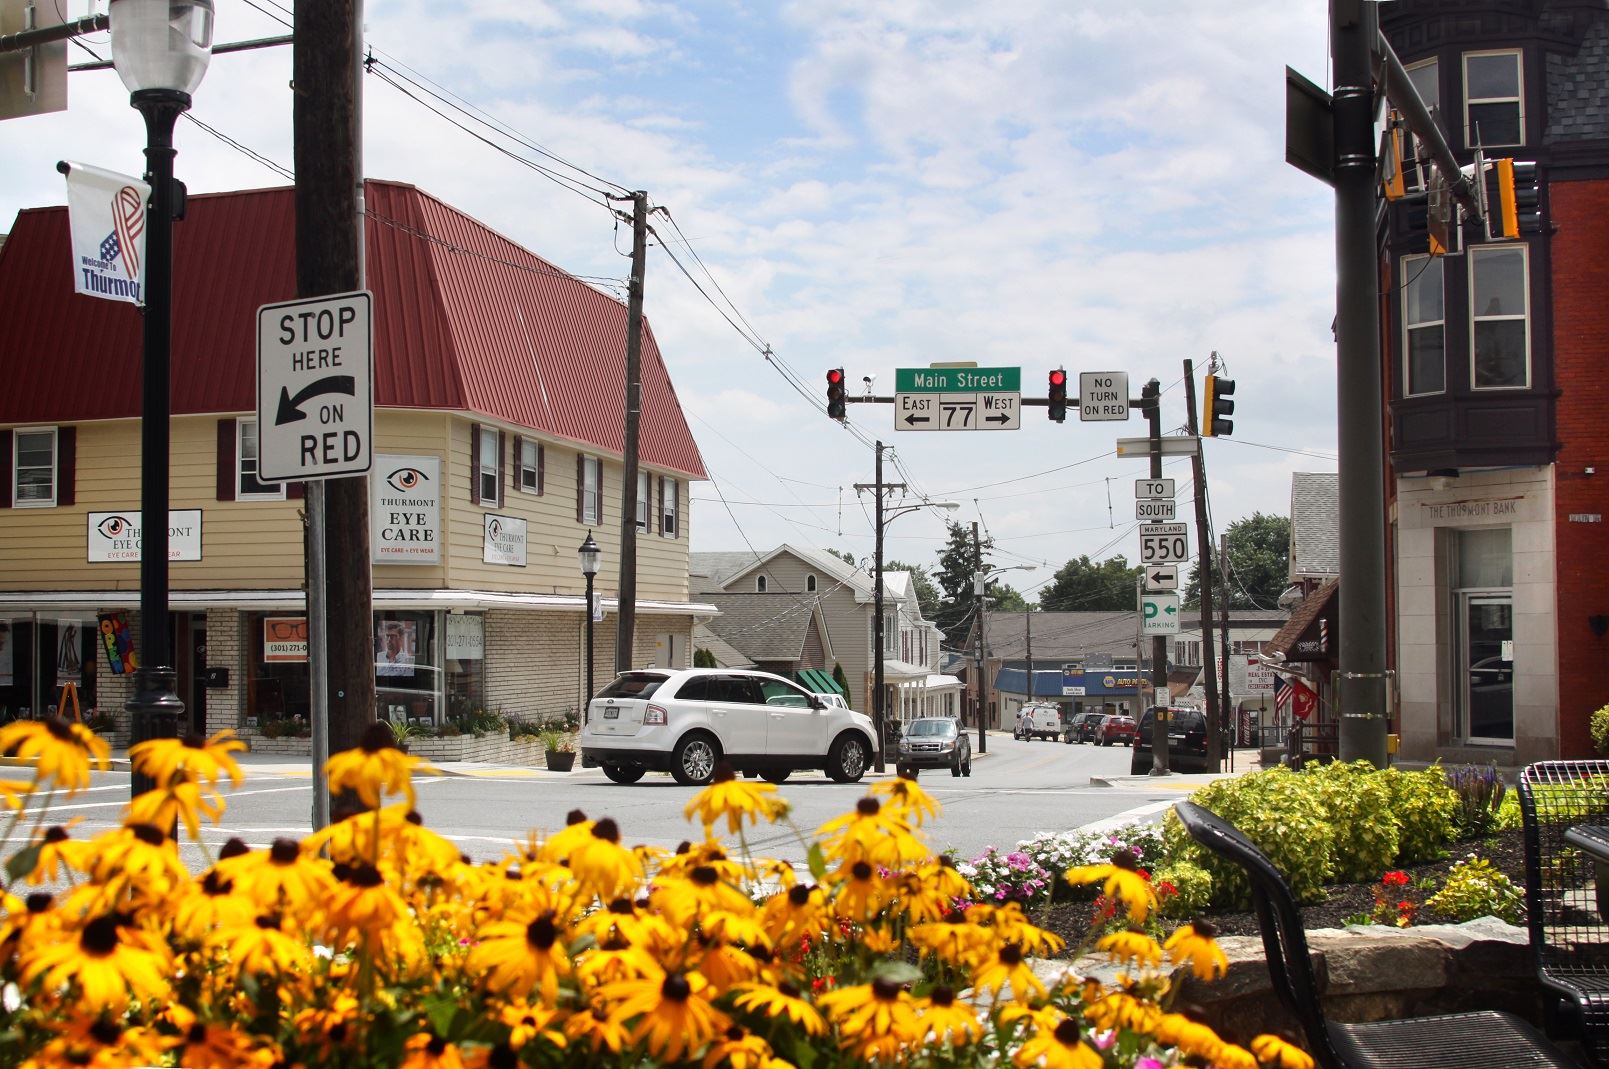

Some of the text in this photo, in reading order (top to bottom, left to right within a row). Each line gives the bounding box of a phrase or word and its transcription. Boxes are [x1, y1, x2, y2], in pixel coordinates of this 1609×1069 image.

[81, 255, 117, 272] Welcome To
[279, 306, 356, 346] STOP
[292, 347, 342, 372] HERE
[914, 372, 1003, 388] Main Street
[1094, 378, 1113, 388] NO
[1090, 391, 1118, 402] TURN
[319, 403, 344, 425] ON
[902, 395, 1014, 428] EAST 77 WEST
[1084, 405, 1125, 416] ON RED
[300, 429, 361, 467] RED
[1146, 483, 1164, 494] TO
[380, 498, 436, 507] THURMONT
[1139, 504, 1173, 516] SOUTH
[1429, 506, 1445, 518] THE
[1493, 501, 1517, 514] BANK
[389, 512, 427, 525] EYE
[125, 526, 193, 538] THONT
[381, 528, 434, 541] CARE
[1144, 525, 1182, 533] MARYLAND
[113, 539, 132, 550] EYE
[1143, 537, 1185, 560] 550
[270, 644, 288, 653] (301)
